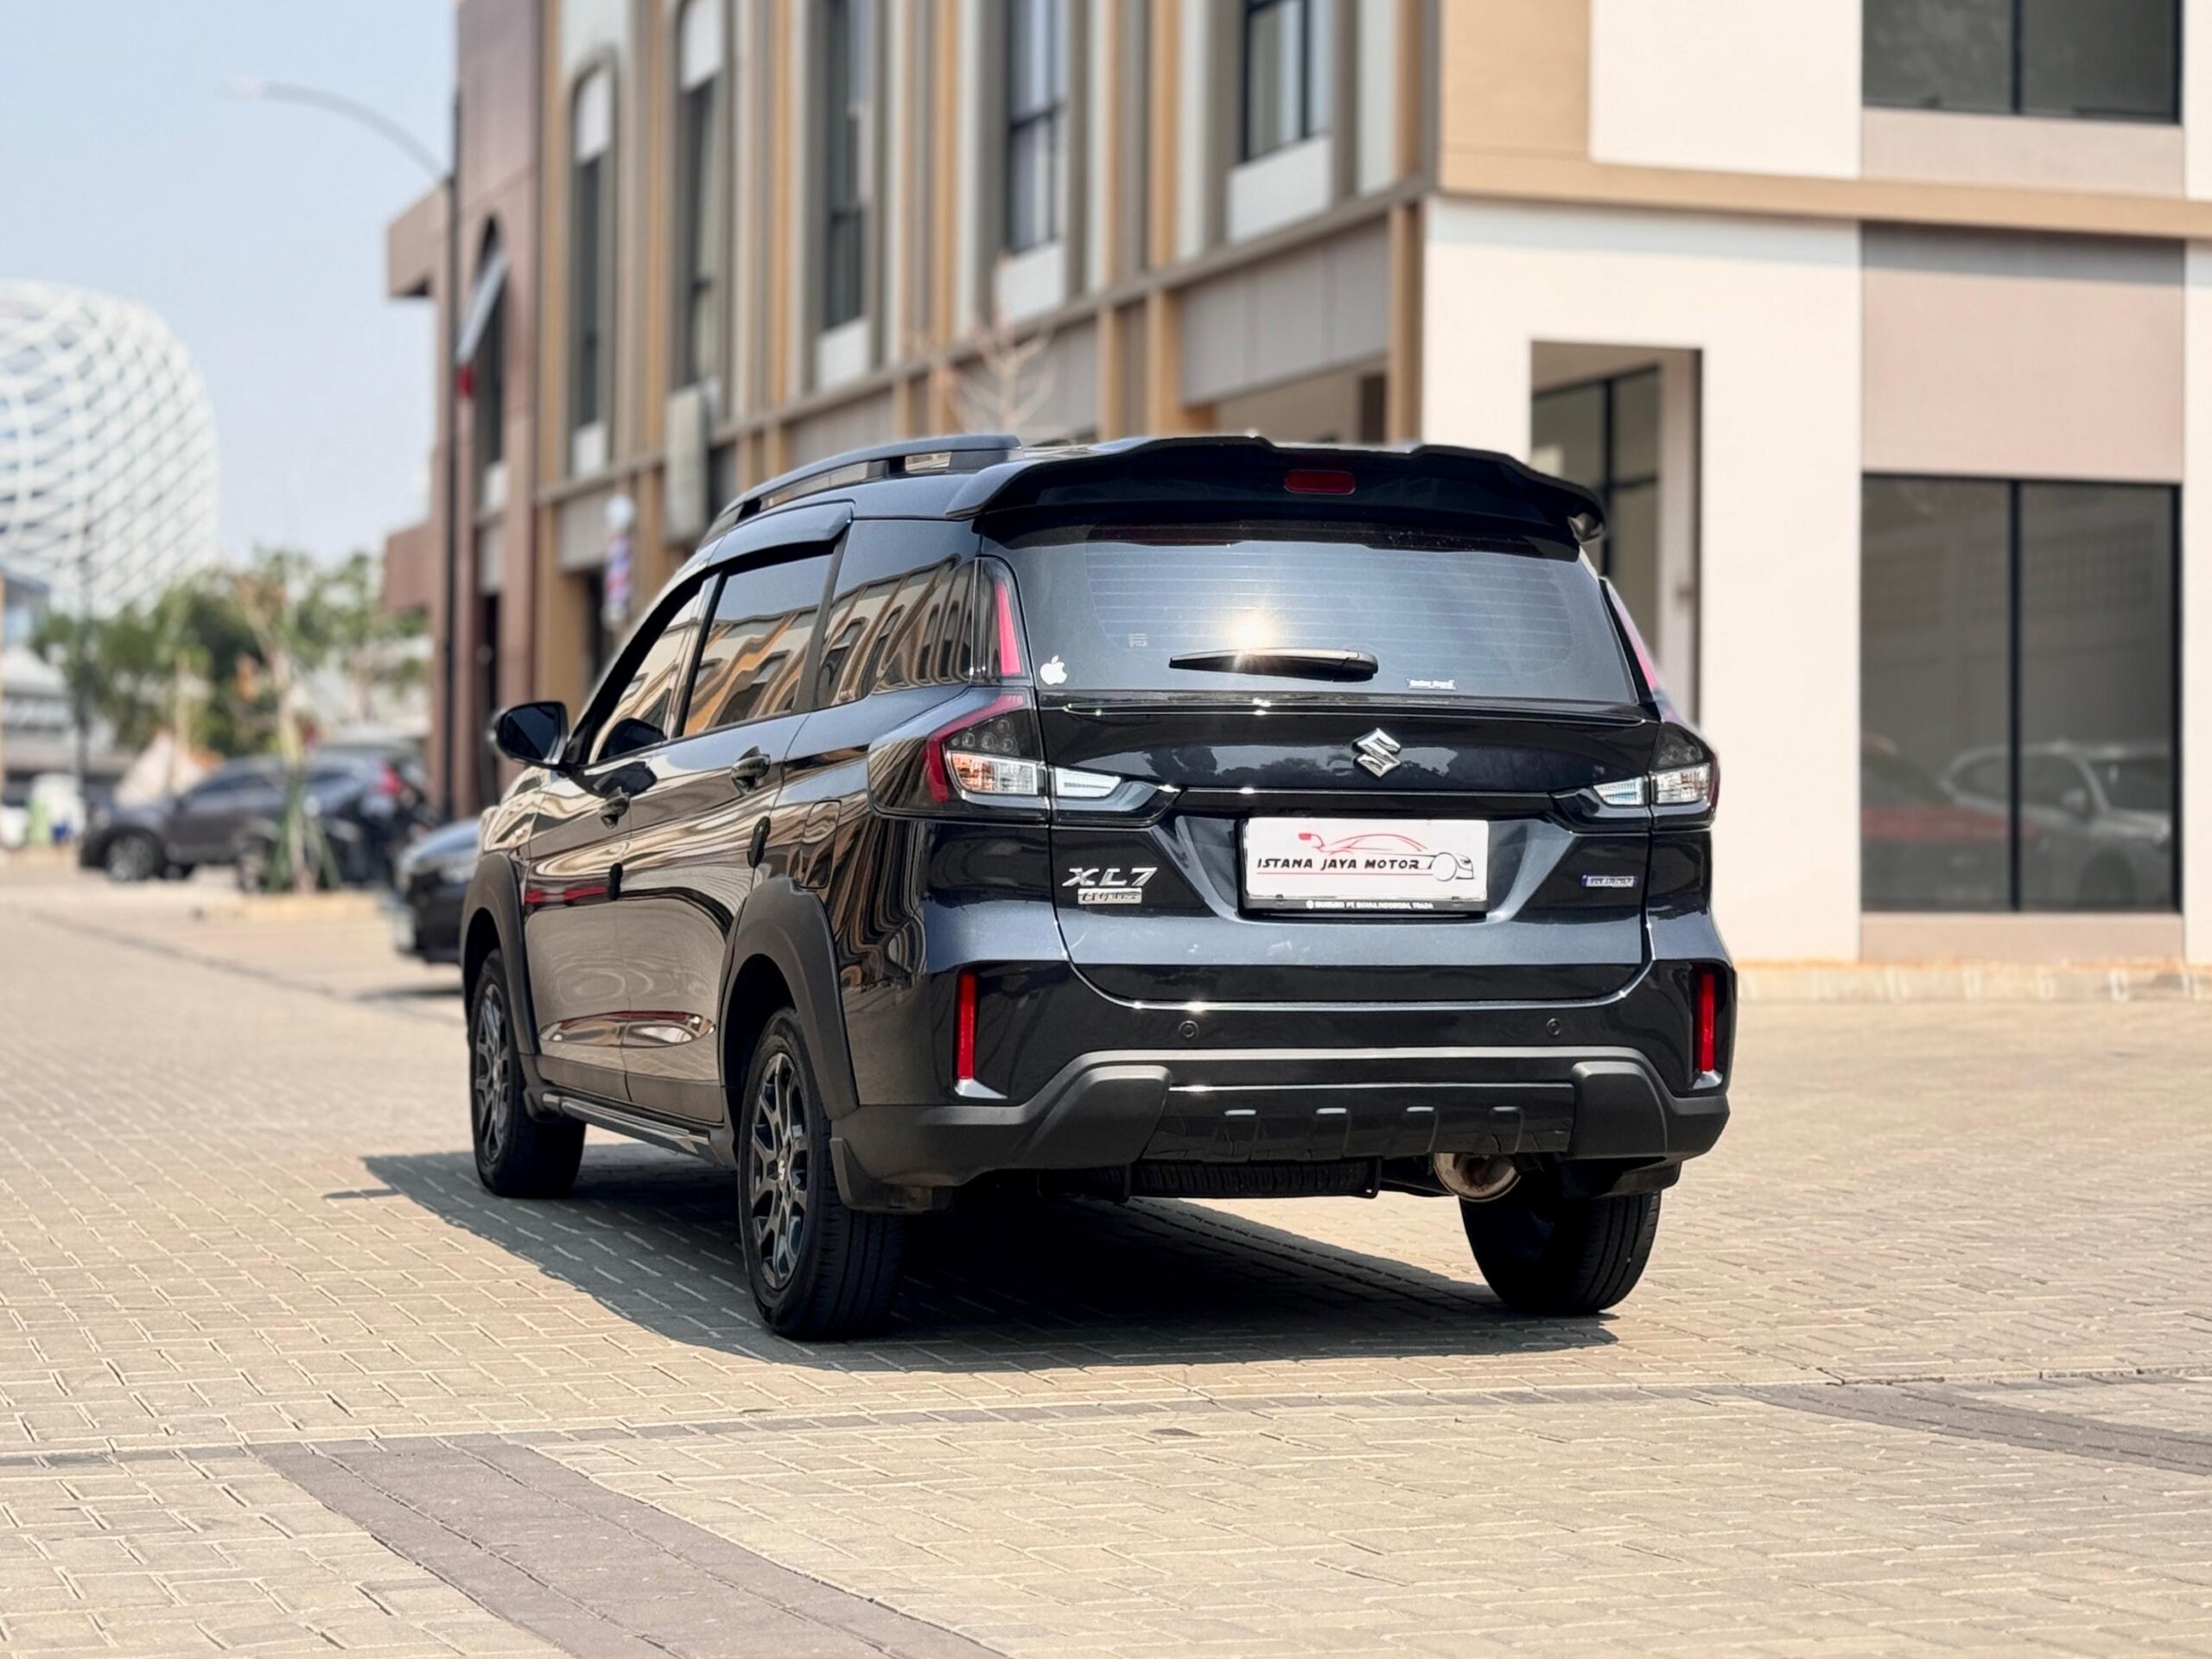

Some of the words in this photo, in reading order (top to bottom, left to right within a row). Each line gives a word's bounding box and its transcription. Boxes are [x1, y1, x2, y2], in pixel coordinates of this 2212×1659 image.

[1257, 858, 1313, 869] ISTANA
[1320, 858, 1357, 871] JAYA
[1364, 859, 1419, 870] MOTOR
[1062, 867, 1158, 887] XL7
